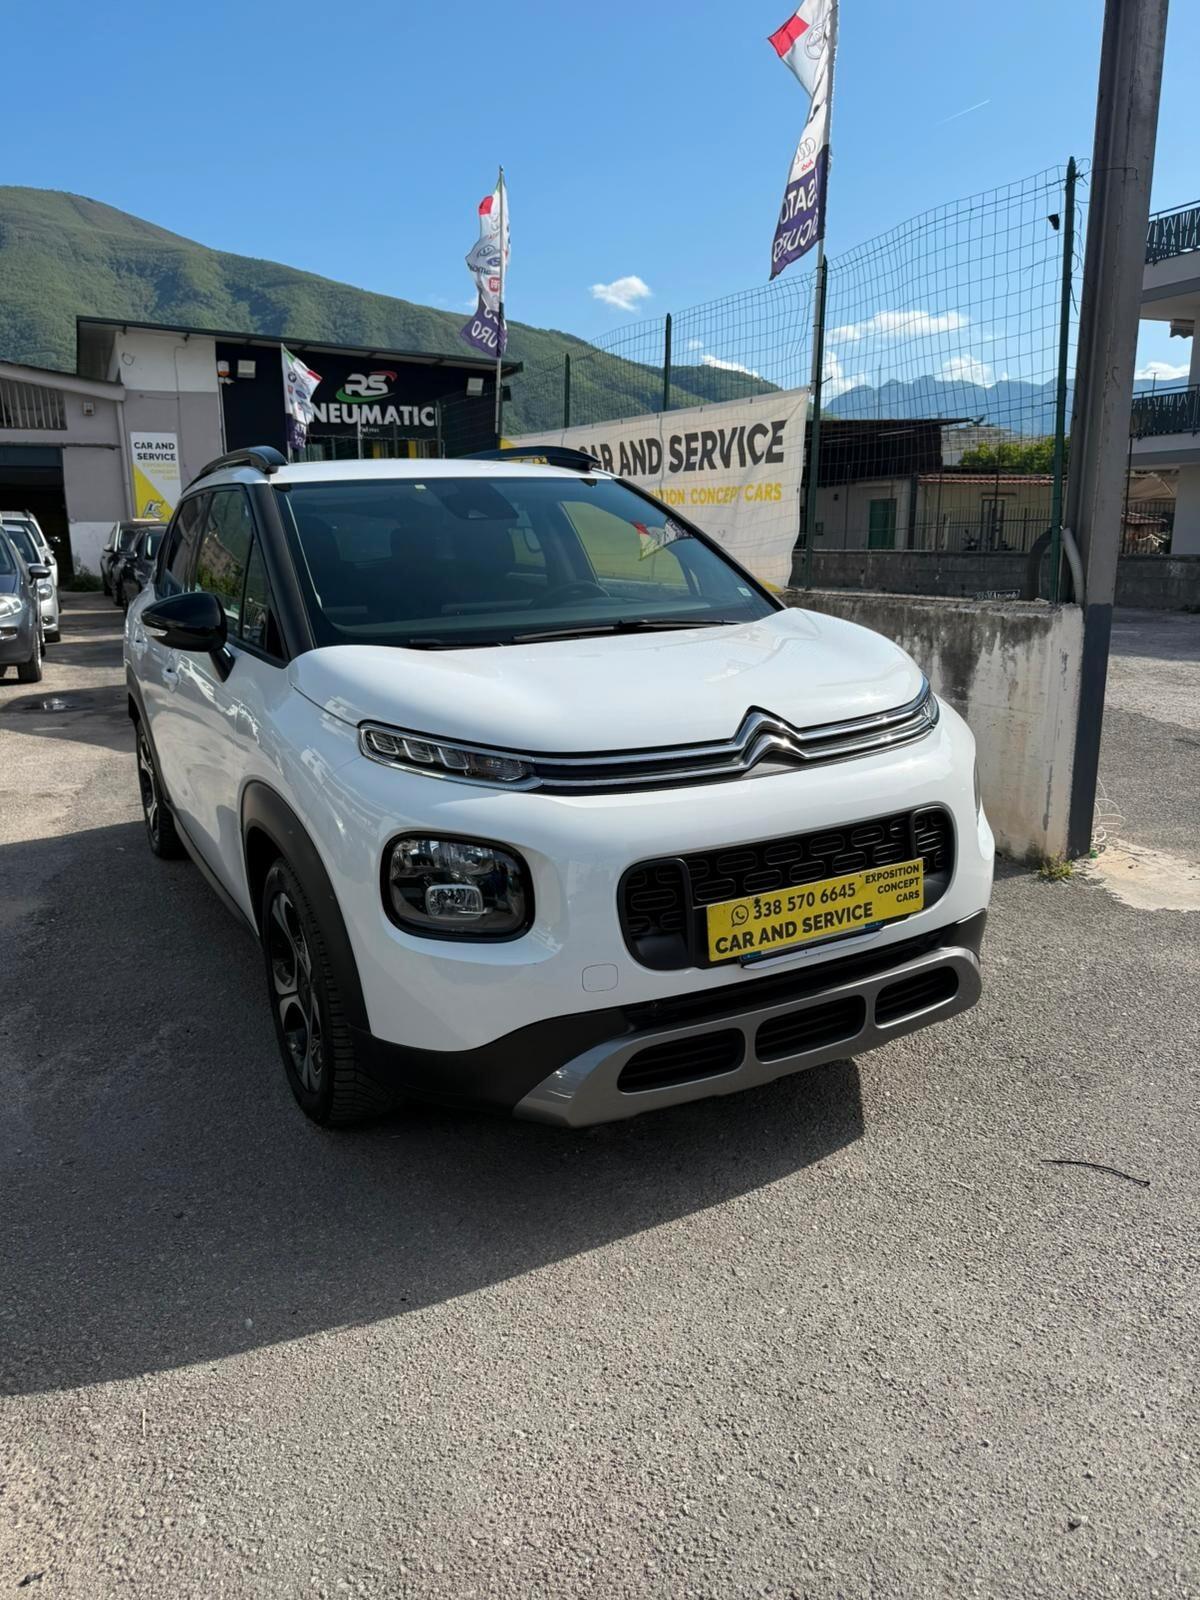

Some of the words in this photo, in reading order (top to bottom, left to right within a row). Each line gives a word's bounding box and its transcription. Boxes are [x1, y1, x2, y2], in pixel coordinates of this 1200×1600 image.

[345, 372, 389, 396] RS
[311, 402, 438, 427] NEUMATIC
[134, 442, 153, 450] CAR
[155, 442, 175, 450] AND
[619, 438, 663, 476] AND
[669, 419, 788, 473] SERVICE
[137, 453, 176, 461] SERVICE
[744, 482, 782, 501] CARS
[865, 864, 919, 884] EXPOSITION
[877, 877, 919, 895] CONCEPT
[753, 899, 782, 920] 338
[787, 891, 815, 912] 570
[820, 882, 856, 904] 6645
[896, 890, 919, 904] CARS
[715, 931, 754, 954] CAR
[758, 920, 797, 945] AND
[802, 902, 873, 933] SERVICE
